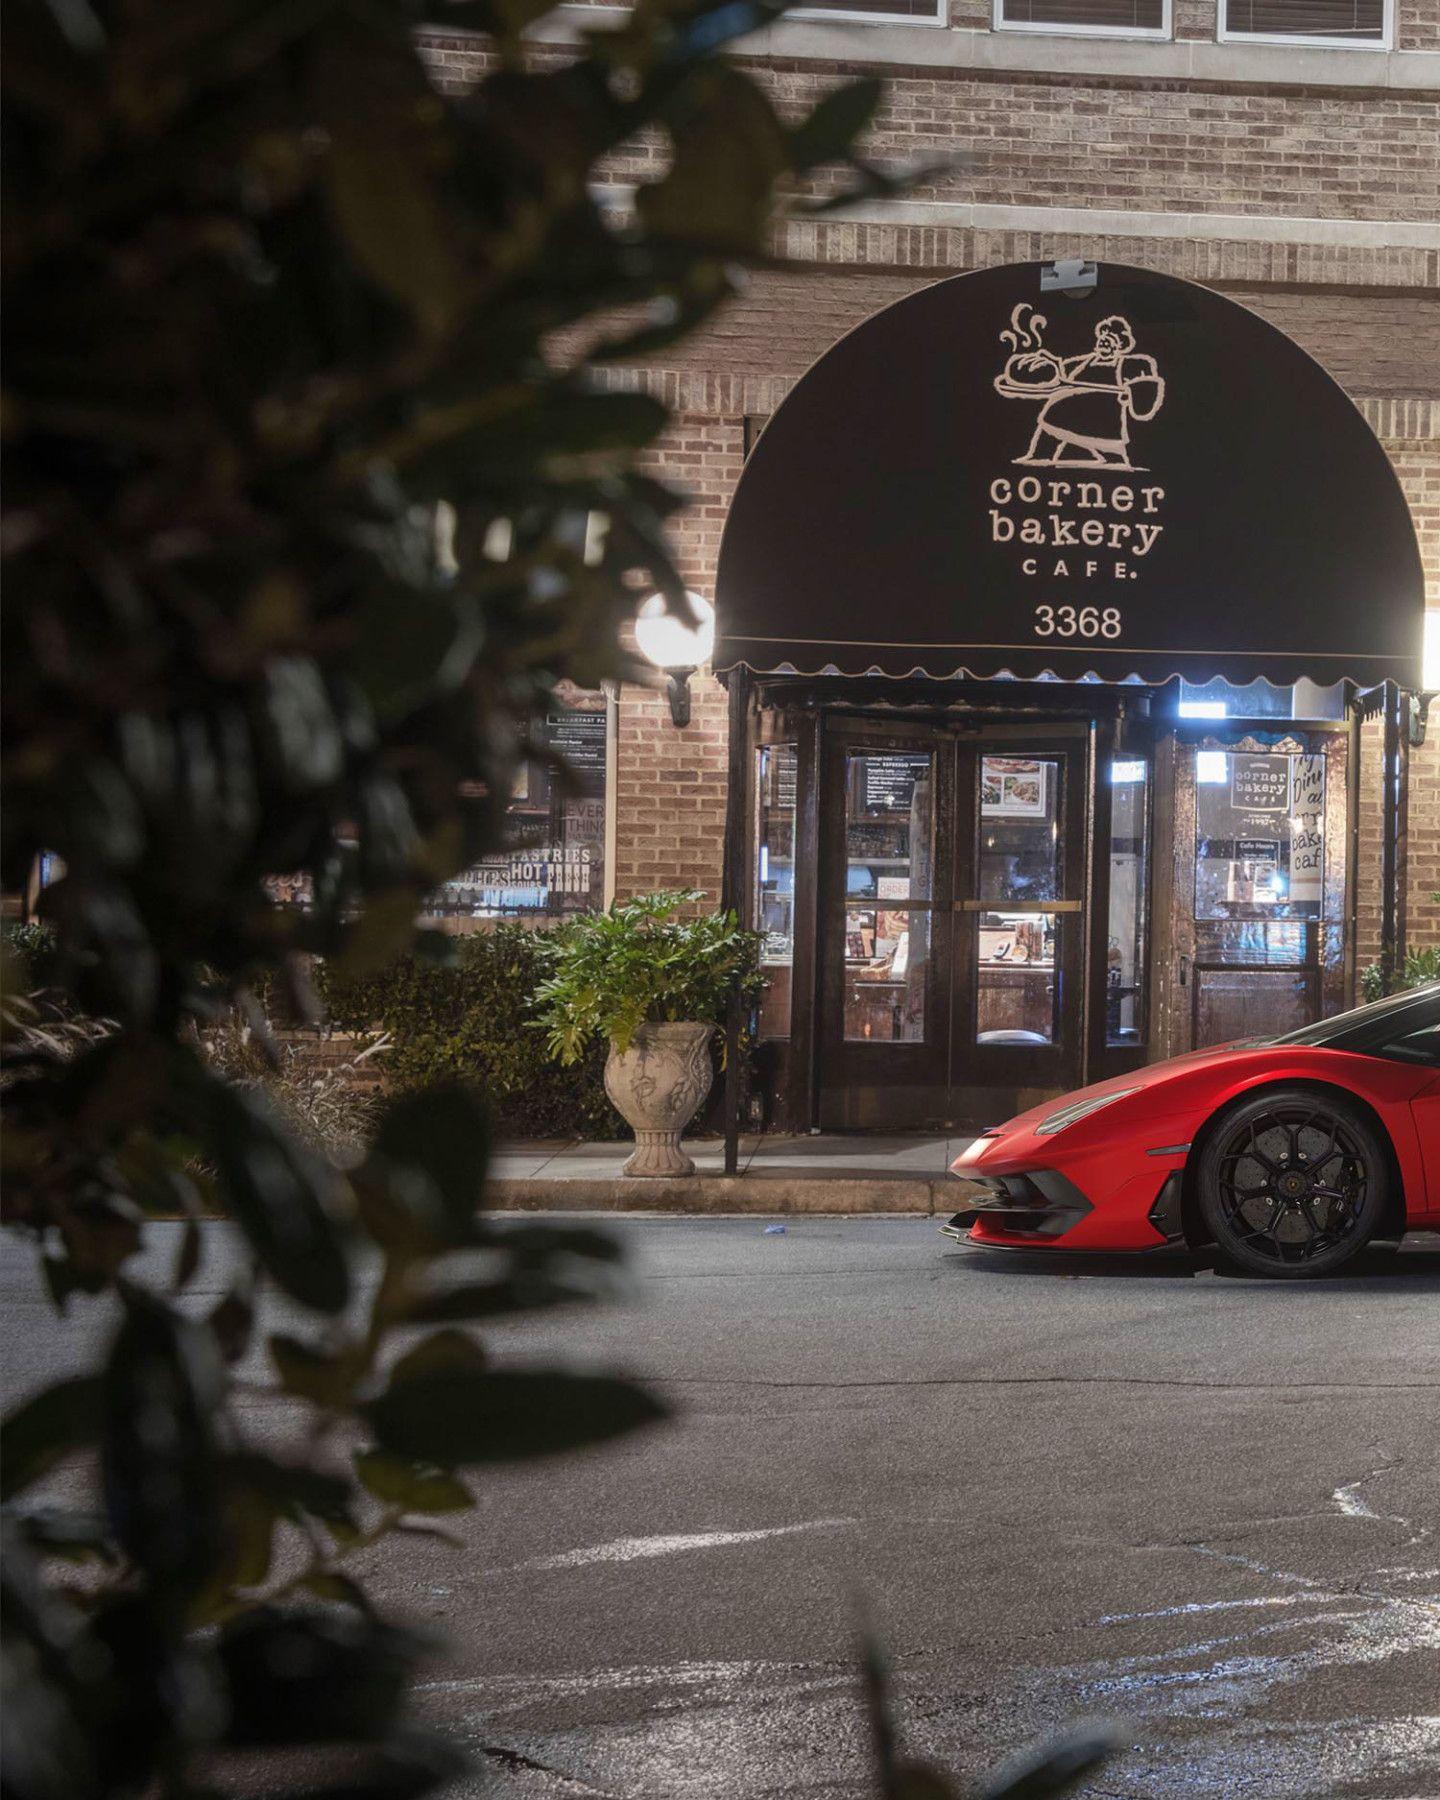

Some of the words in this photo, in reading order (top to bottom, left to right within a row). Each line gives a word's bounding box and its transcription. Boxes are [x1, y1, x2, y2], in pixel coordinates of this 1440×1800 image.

[990, 476, 1165, 513] corner
[989, 509, 1164, 556] bakery
[1034, 604, 1122, 639] 3368
[1236, 781, 1286, 795] bakery
[511, 863, 542, 880] HOT
